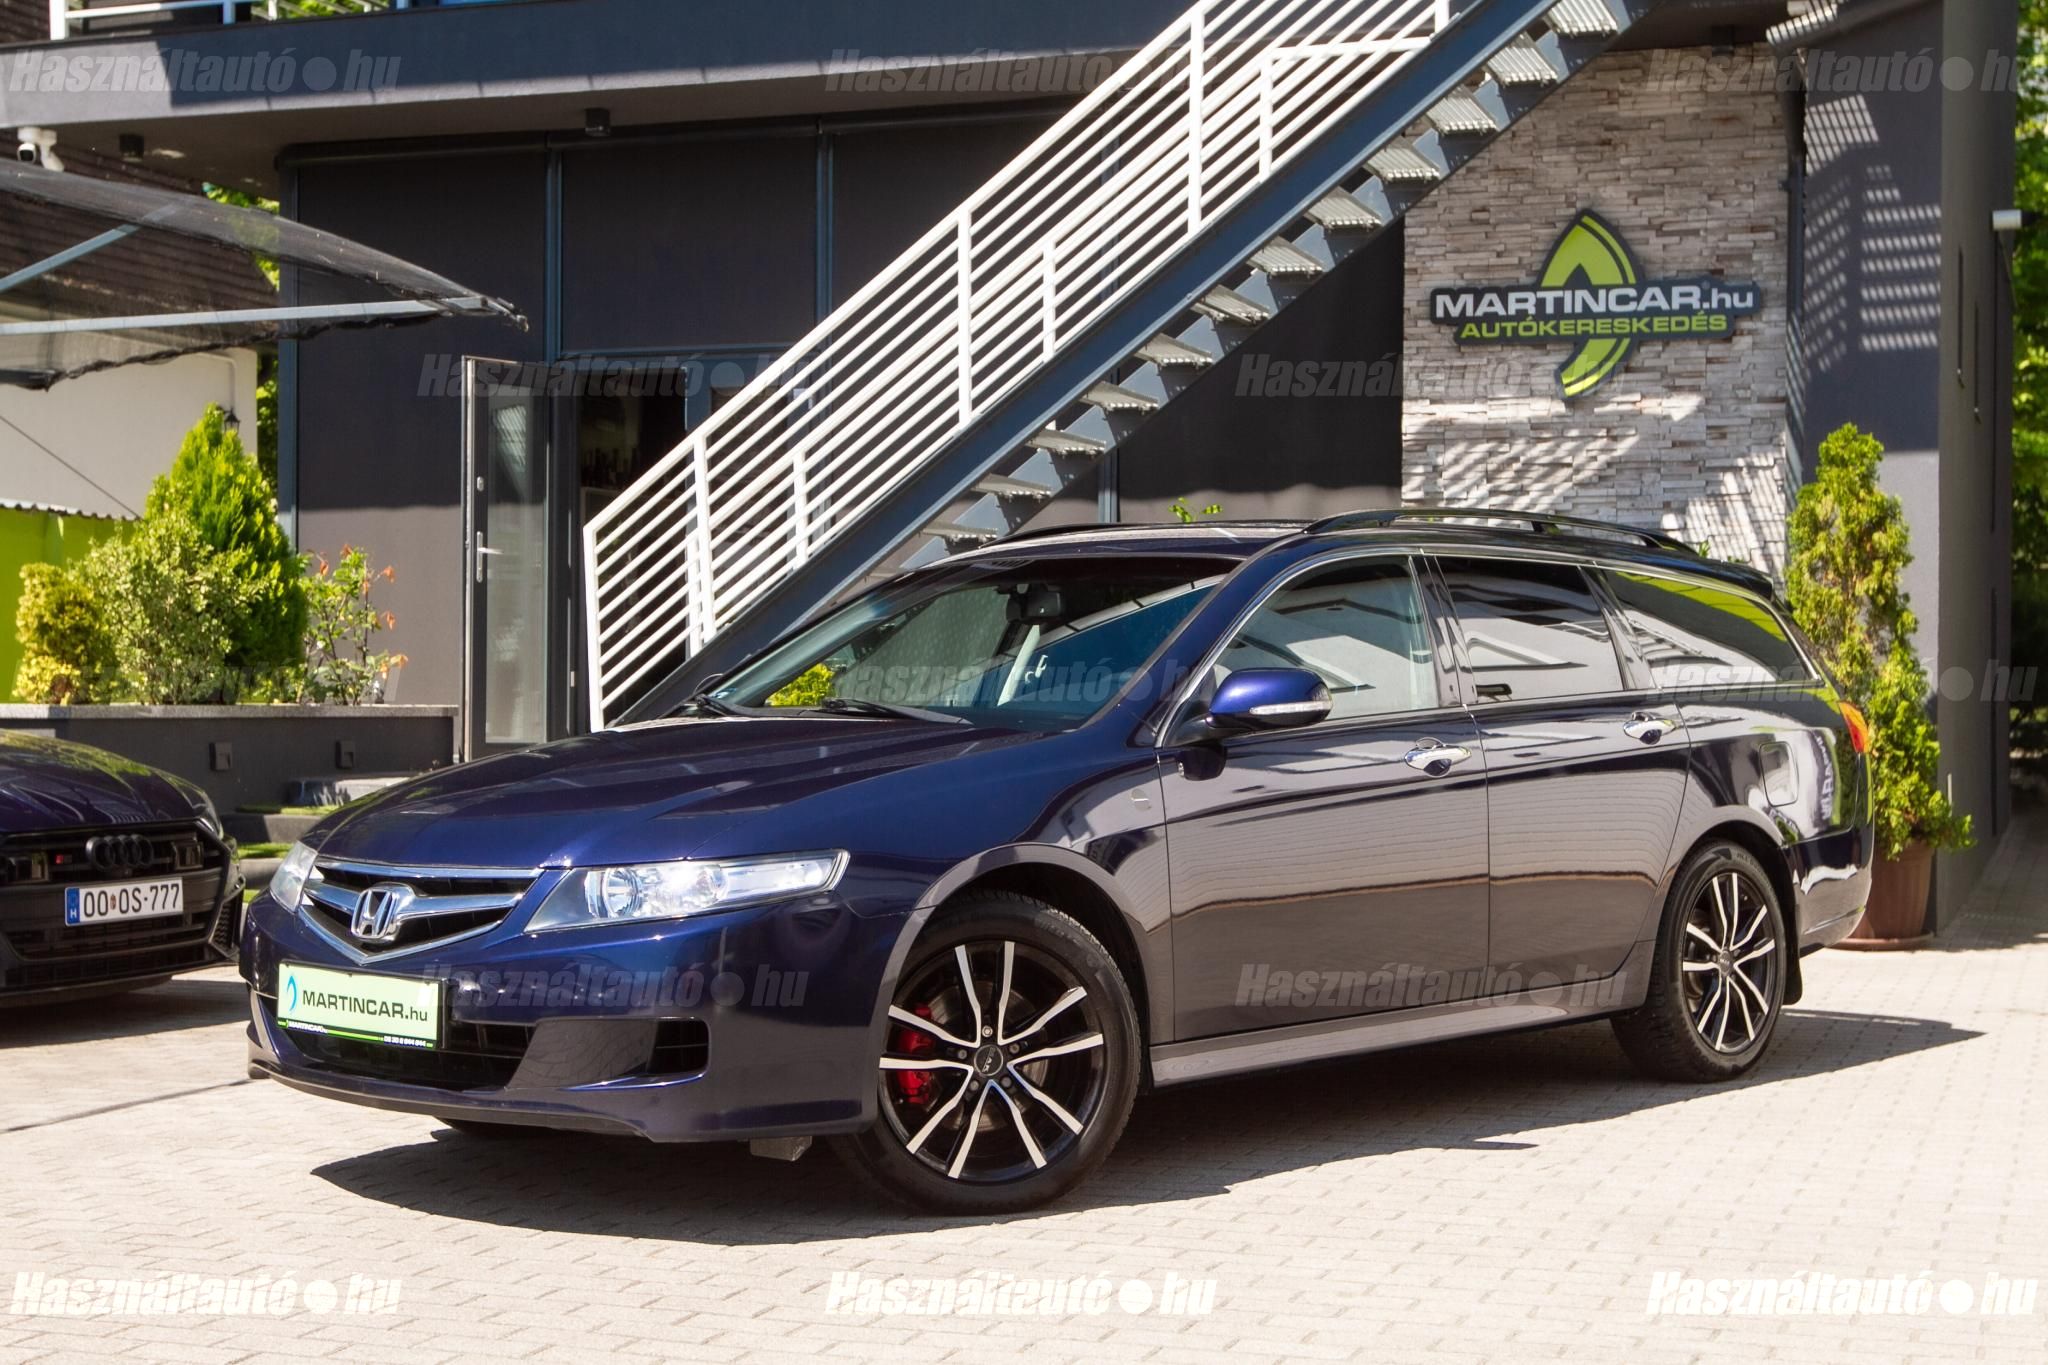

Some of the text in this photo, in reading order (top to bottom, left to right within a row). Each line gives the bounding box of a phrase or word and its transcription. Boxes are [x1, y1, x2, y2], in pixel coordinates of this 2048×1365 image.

[1435, 285, 1754, 319] MARTINCAR.hu
[1460, 310, 1728, 339] AUTÓKERESKEDÉS
[302, 989, 428, 1022] MARTINCAR.hu
